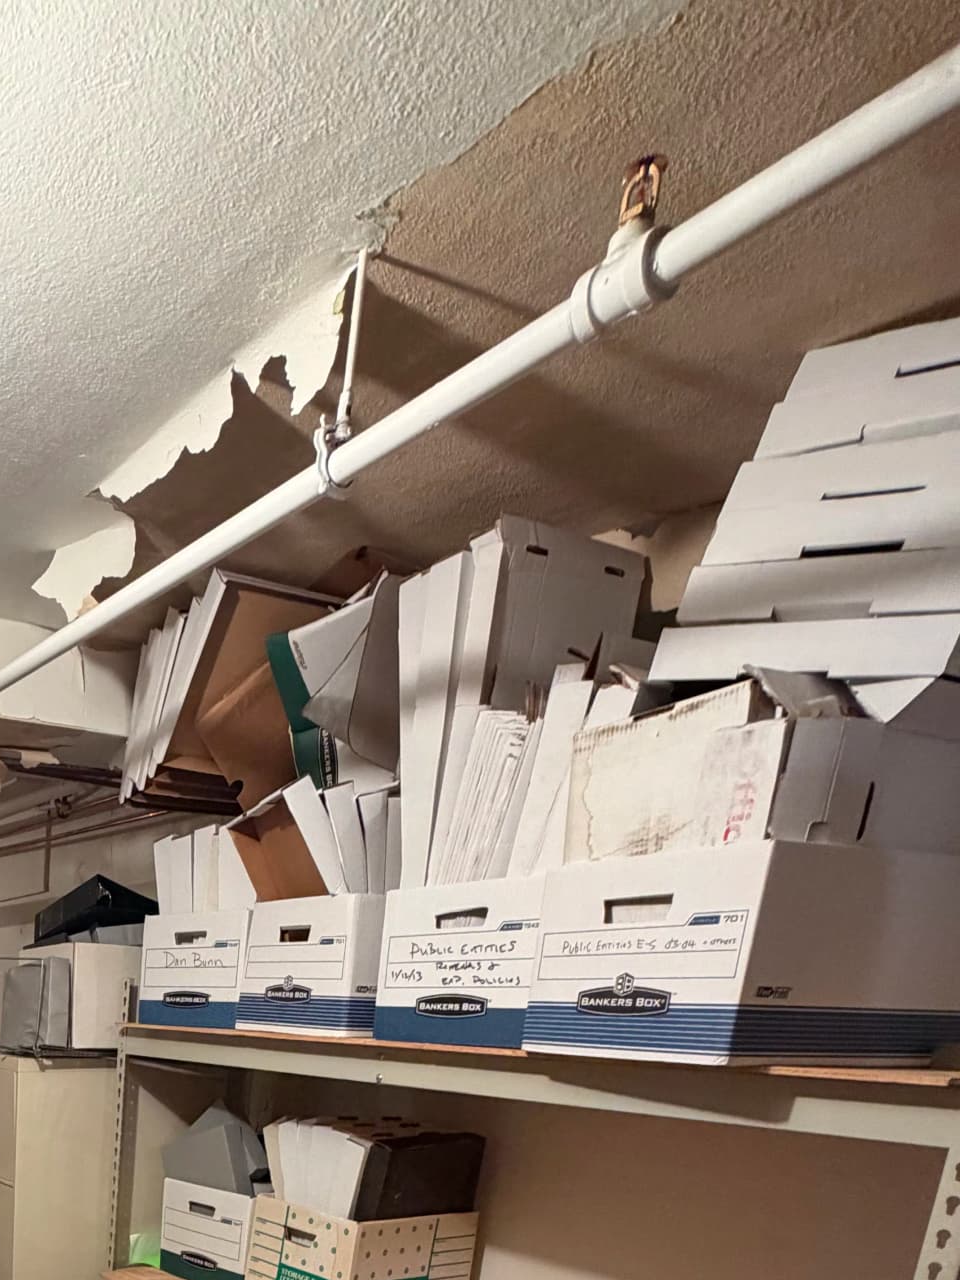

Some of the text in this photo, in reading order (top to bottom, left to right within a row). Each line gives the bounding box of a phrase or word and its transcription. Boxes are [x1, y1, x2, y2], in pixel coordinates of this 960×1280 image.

[723, 914, 744, 923] 701
[164, 952, 225, 968] Dan Bunn
[581, 997, 662, 1007] BANKERS BOX
[419, 1003, 482, 1011] BANKERS BOX
